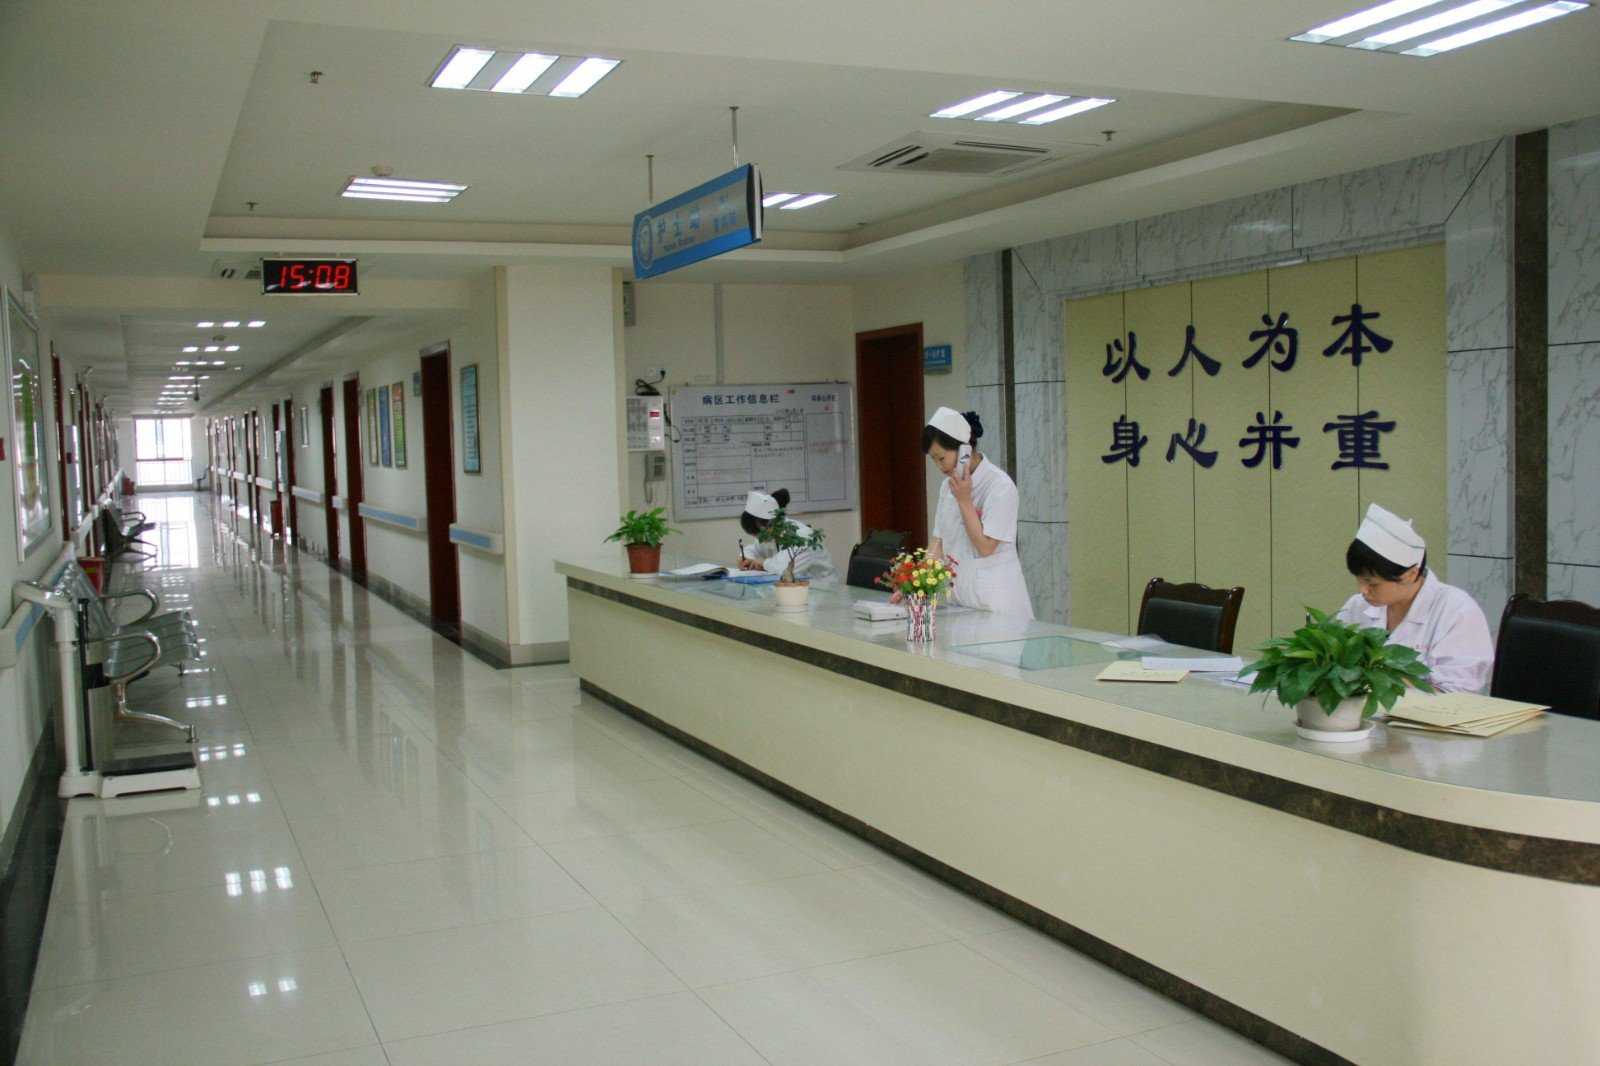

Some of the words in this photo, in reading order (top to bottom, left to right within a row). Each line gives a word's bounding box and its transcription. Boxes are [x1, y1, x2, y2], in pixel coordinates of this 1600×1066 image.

[280, 265, 350, 290] 15:08
[1103, 304, 1393, 383] 以人为本
[702, 394, 780, 405] 病区工作信息栏
[1102, 410, 1396, 469] 身心并重
